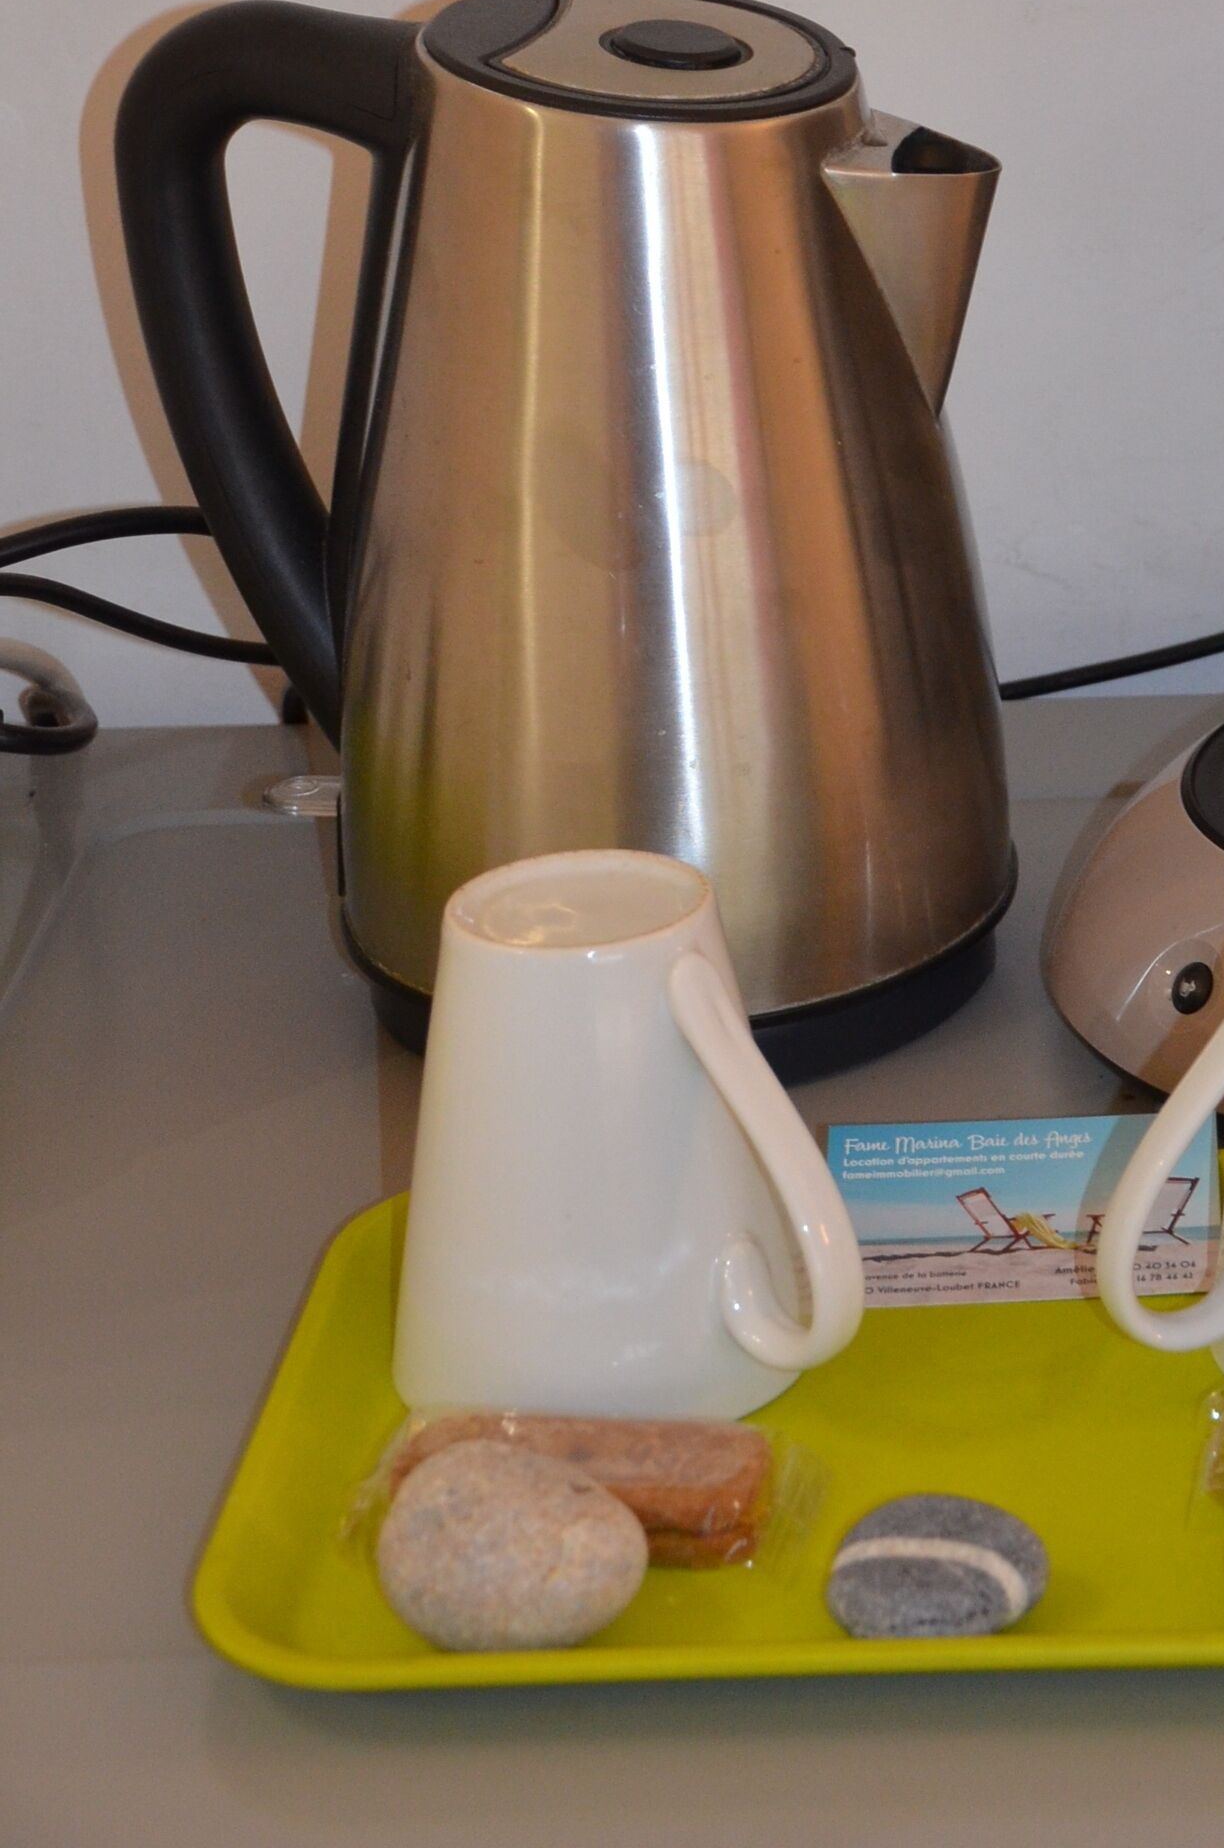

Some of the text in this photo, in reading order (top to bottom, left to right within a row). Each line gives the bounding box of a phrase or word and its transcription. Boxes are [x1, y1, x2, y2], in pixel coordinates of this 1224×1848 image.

[845, 1131, 1092, 1155] Fame Marina Baie des Anges
[843, 1157, 895, 1168] Location
[990, 1155, 1006, 1163] en
[1008, 1152, 1046, 1162] courte
[878, 1283, 974, 1294] Villeneuve-Loubet
[977, 1280, 1021, 1289] FRANCE
